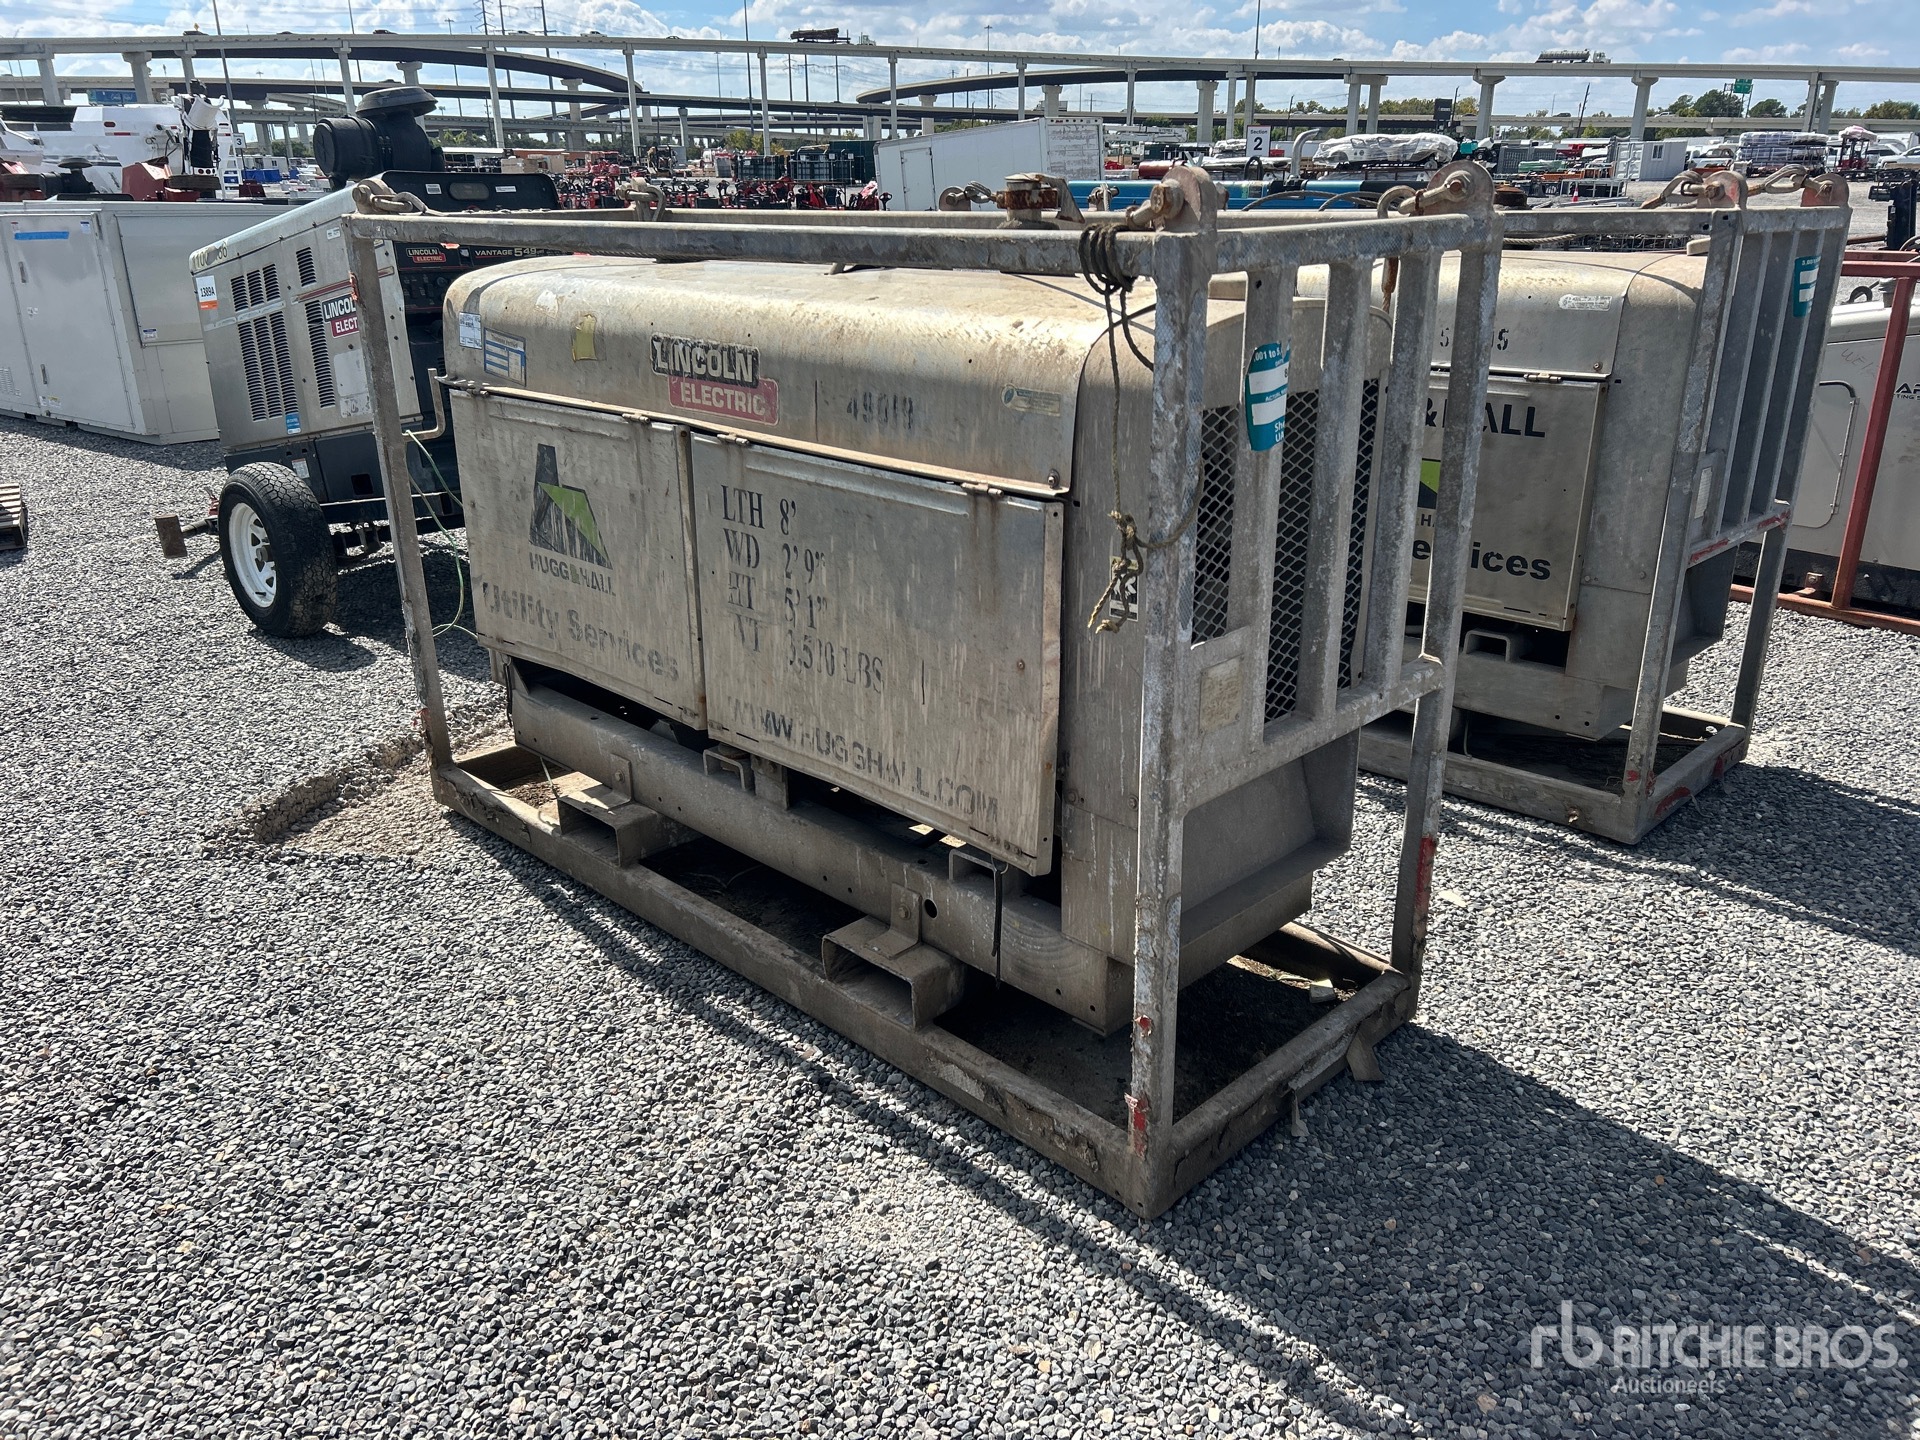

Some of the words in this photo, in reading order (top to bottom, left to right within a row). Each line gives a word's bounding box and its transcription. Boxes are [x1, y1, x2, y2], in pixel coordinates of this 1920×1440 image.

[1253, 137, 1263, 151] 2
[408, 248, 438, 256] LINCOLN
[200, 287, 215, 298] 1389A
[323, 295, 357, 319] LINCOL
[335, 320, 358, 334] ELECT
[654, 339, 753, 383] LINCOLN
[680, 382, 766, 416] ELECTRIC
[1442, 399, 1546, 438] ALL
[721, 484, 766, 530] LTH
[723, 528, 760, 569] WD
[1412, 539, 1551, 581] eices
[482, 581, 560, 640] Utility
[566, 609, 679, 682] Services
